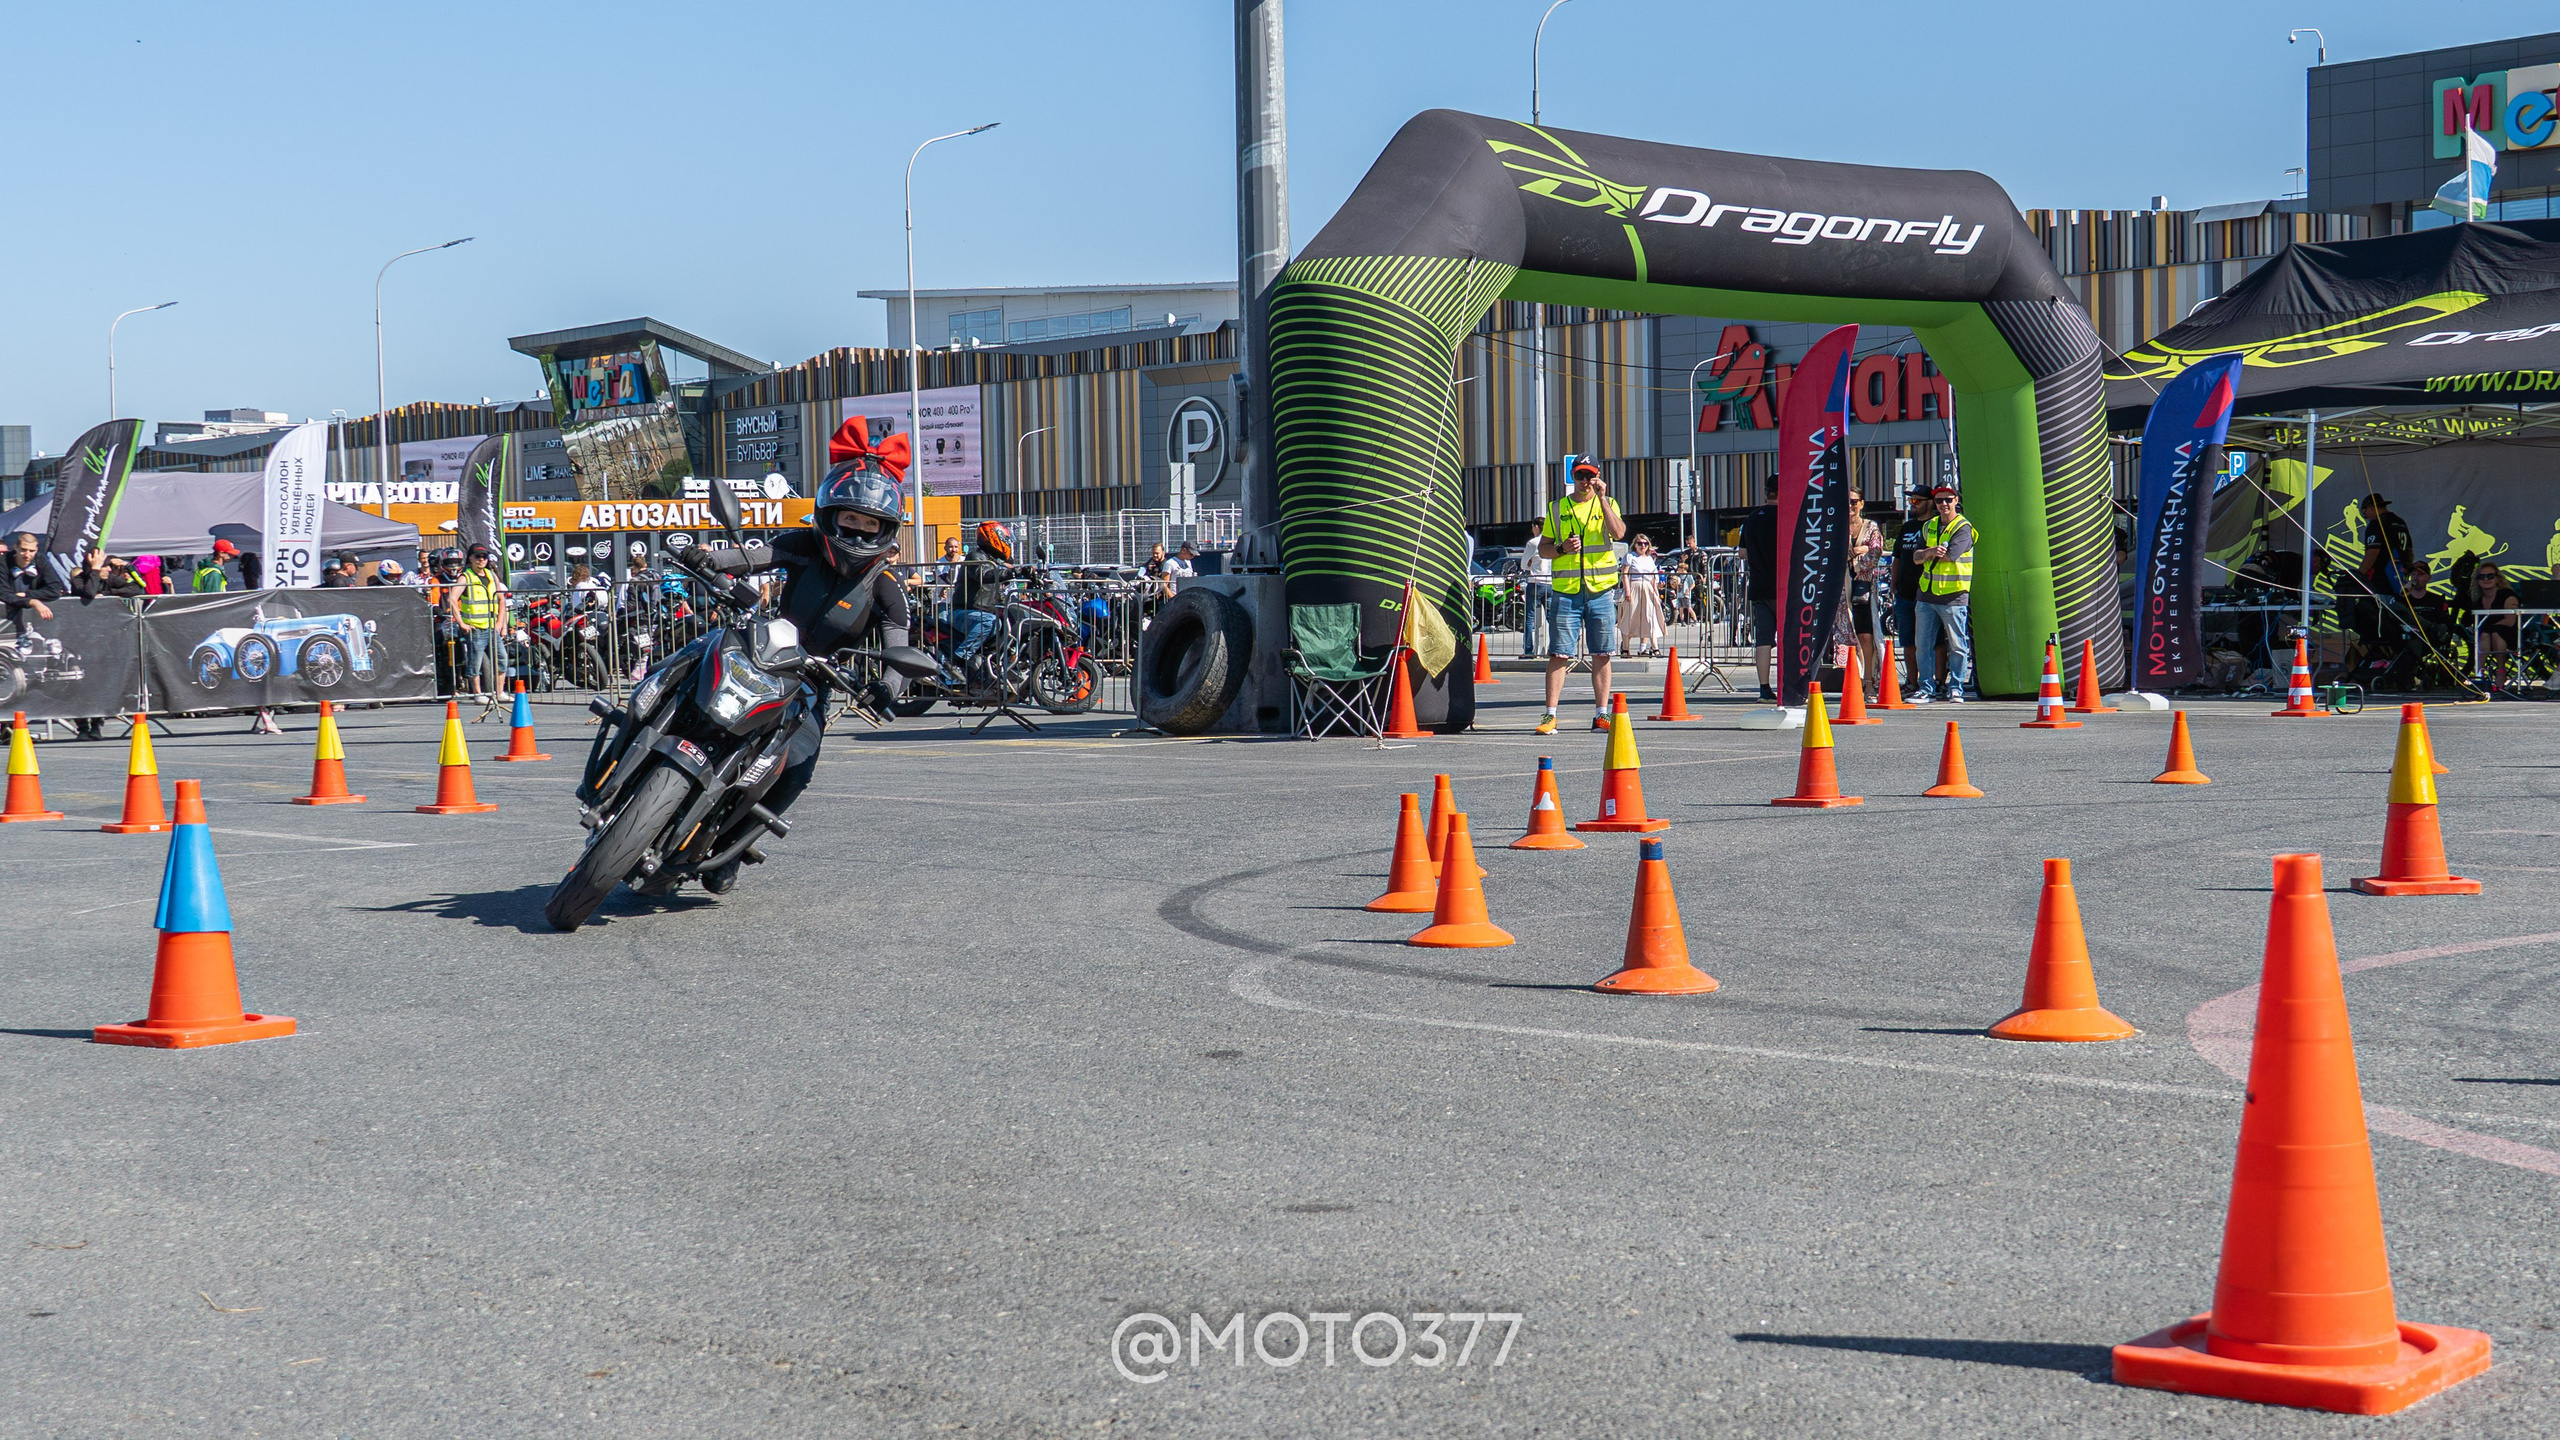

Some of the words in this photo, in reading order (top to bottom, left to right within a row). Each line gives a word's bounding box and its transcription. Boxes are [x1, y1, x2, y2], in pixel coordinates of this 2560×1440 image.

[2441, 80, 2560, 150] Ме
[1638, 187, 1985, 255] Dragonfly
[1698, 325, 1949, 432] Аан
[736, 411, 778, 436] ВКУСНЫЙ
[525, 465, 547, 481] LIME
[737, 441, 778, 463] БУЛЬВАР
[1828, 425, 1838, 487] TEAM
[2234, 455, 2243, 474] P
[279, 460, 289, 535] МОТОСАЛОН
[290, 457, 304, 535] УВЛЕЧЁННЫХ
[304, 493, 316, 535] ЛЮДЕЙ
[579, 502, 783, 528] АВТОЗАПЧСТИ
[503, 518, 556, 528] ПОНЕЦ
[2149, 440, 2192, 676] MOTOGYMKHANA
